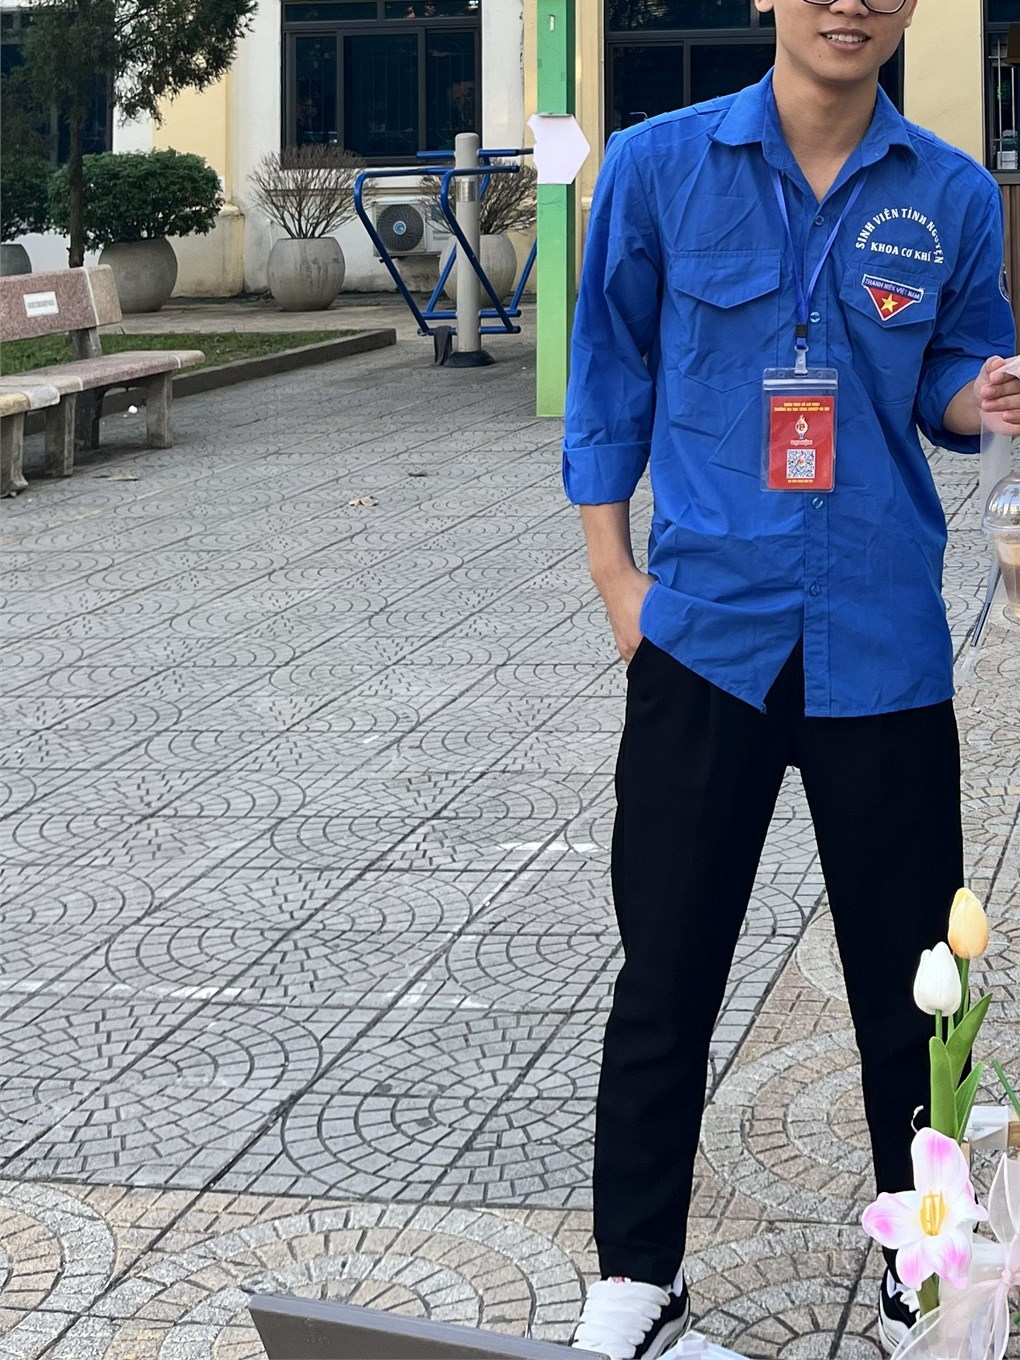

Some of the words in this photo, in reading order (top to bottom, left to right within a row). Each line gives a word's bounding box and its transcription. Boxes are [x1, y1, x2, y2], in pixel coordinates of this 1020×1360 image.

[855, 222, 876, 250] SINH
[873, 208, 899, 225] VIÊN
[901, 207, 927, 225] TÌNH
[870, 242, 899, 255] KHOA
[901, 247, 914, 258] CƠ
[914, 250, 932, 262] KHÍ
